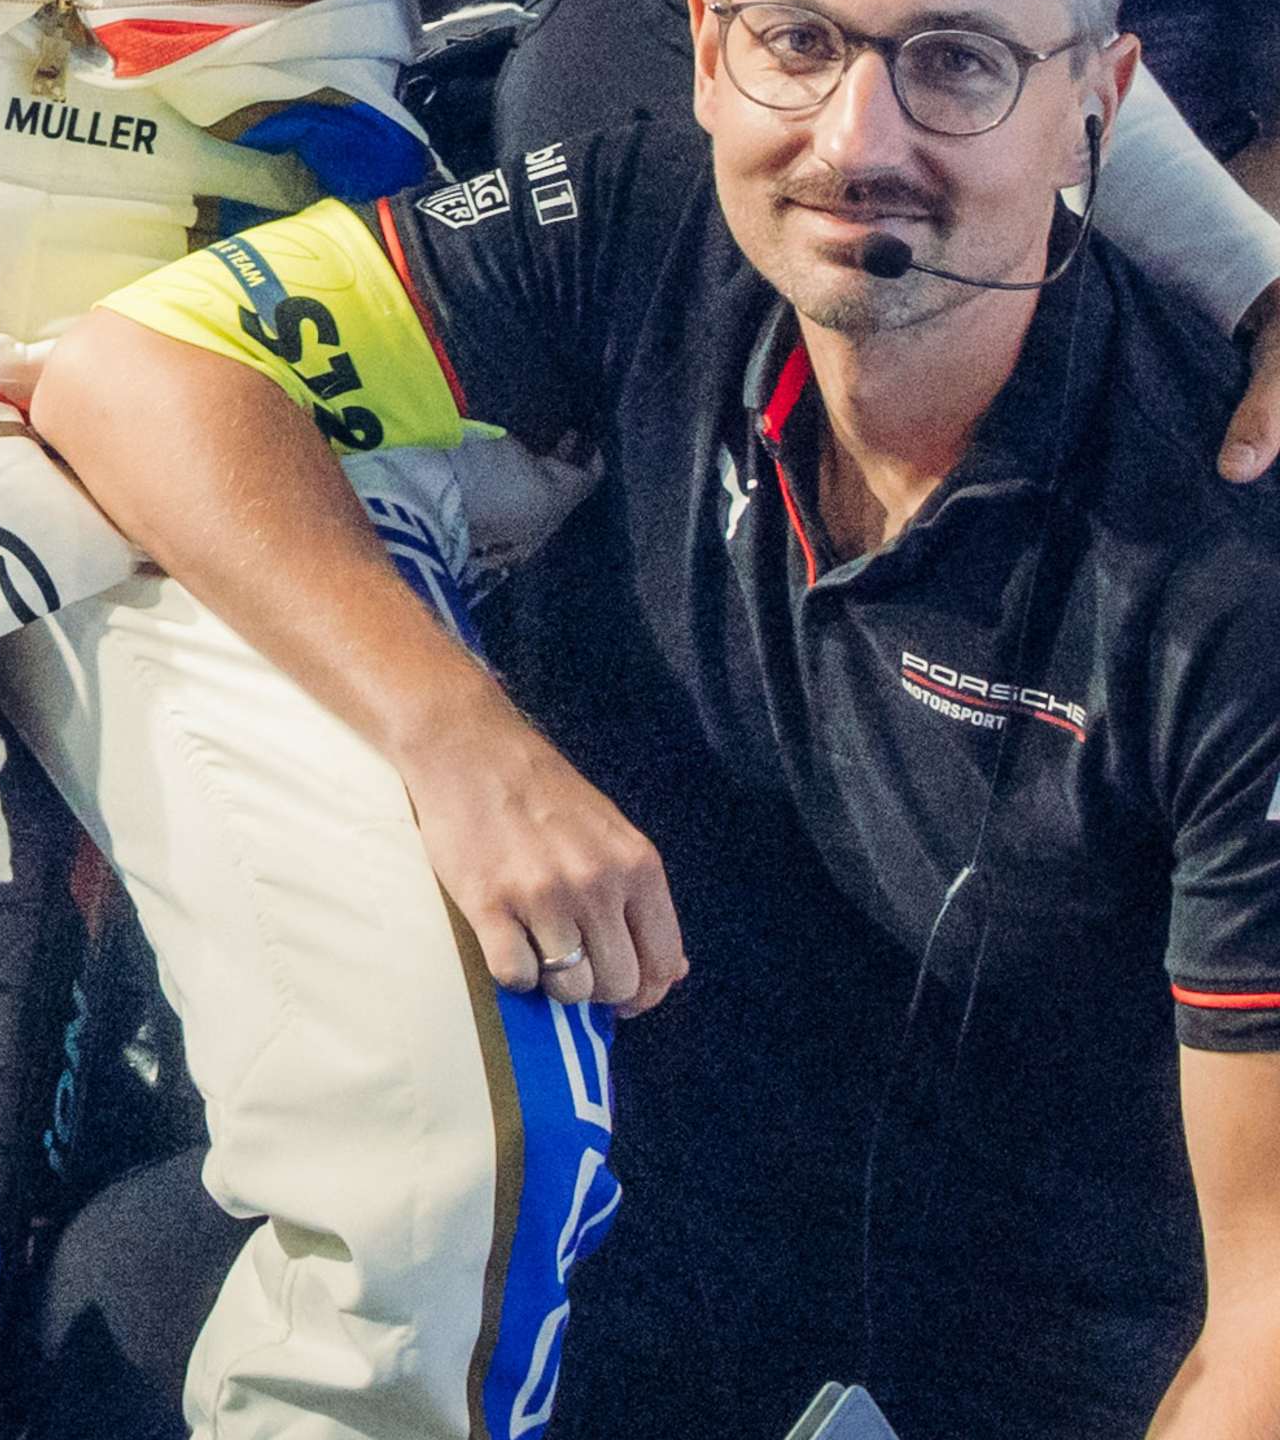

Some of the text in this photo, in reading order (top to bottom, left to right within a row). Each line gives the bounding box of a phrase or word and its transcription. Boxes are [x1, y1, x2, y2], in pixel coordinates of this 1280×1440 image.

[227, 249, 267, 288] TEAM
[901, 650, 1087, 727] PORSCHE
[901, 677, 1008, 731] MOTORSPORT
